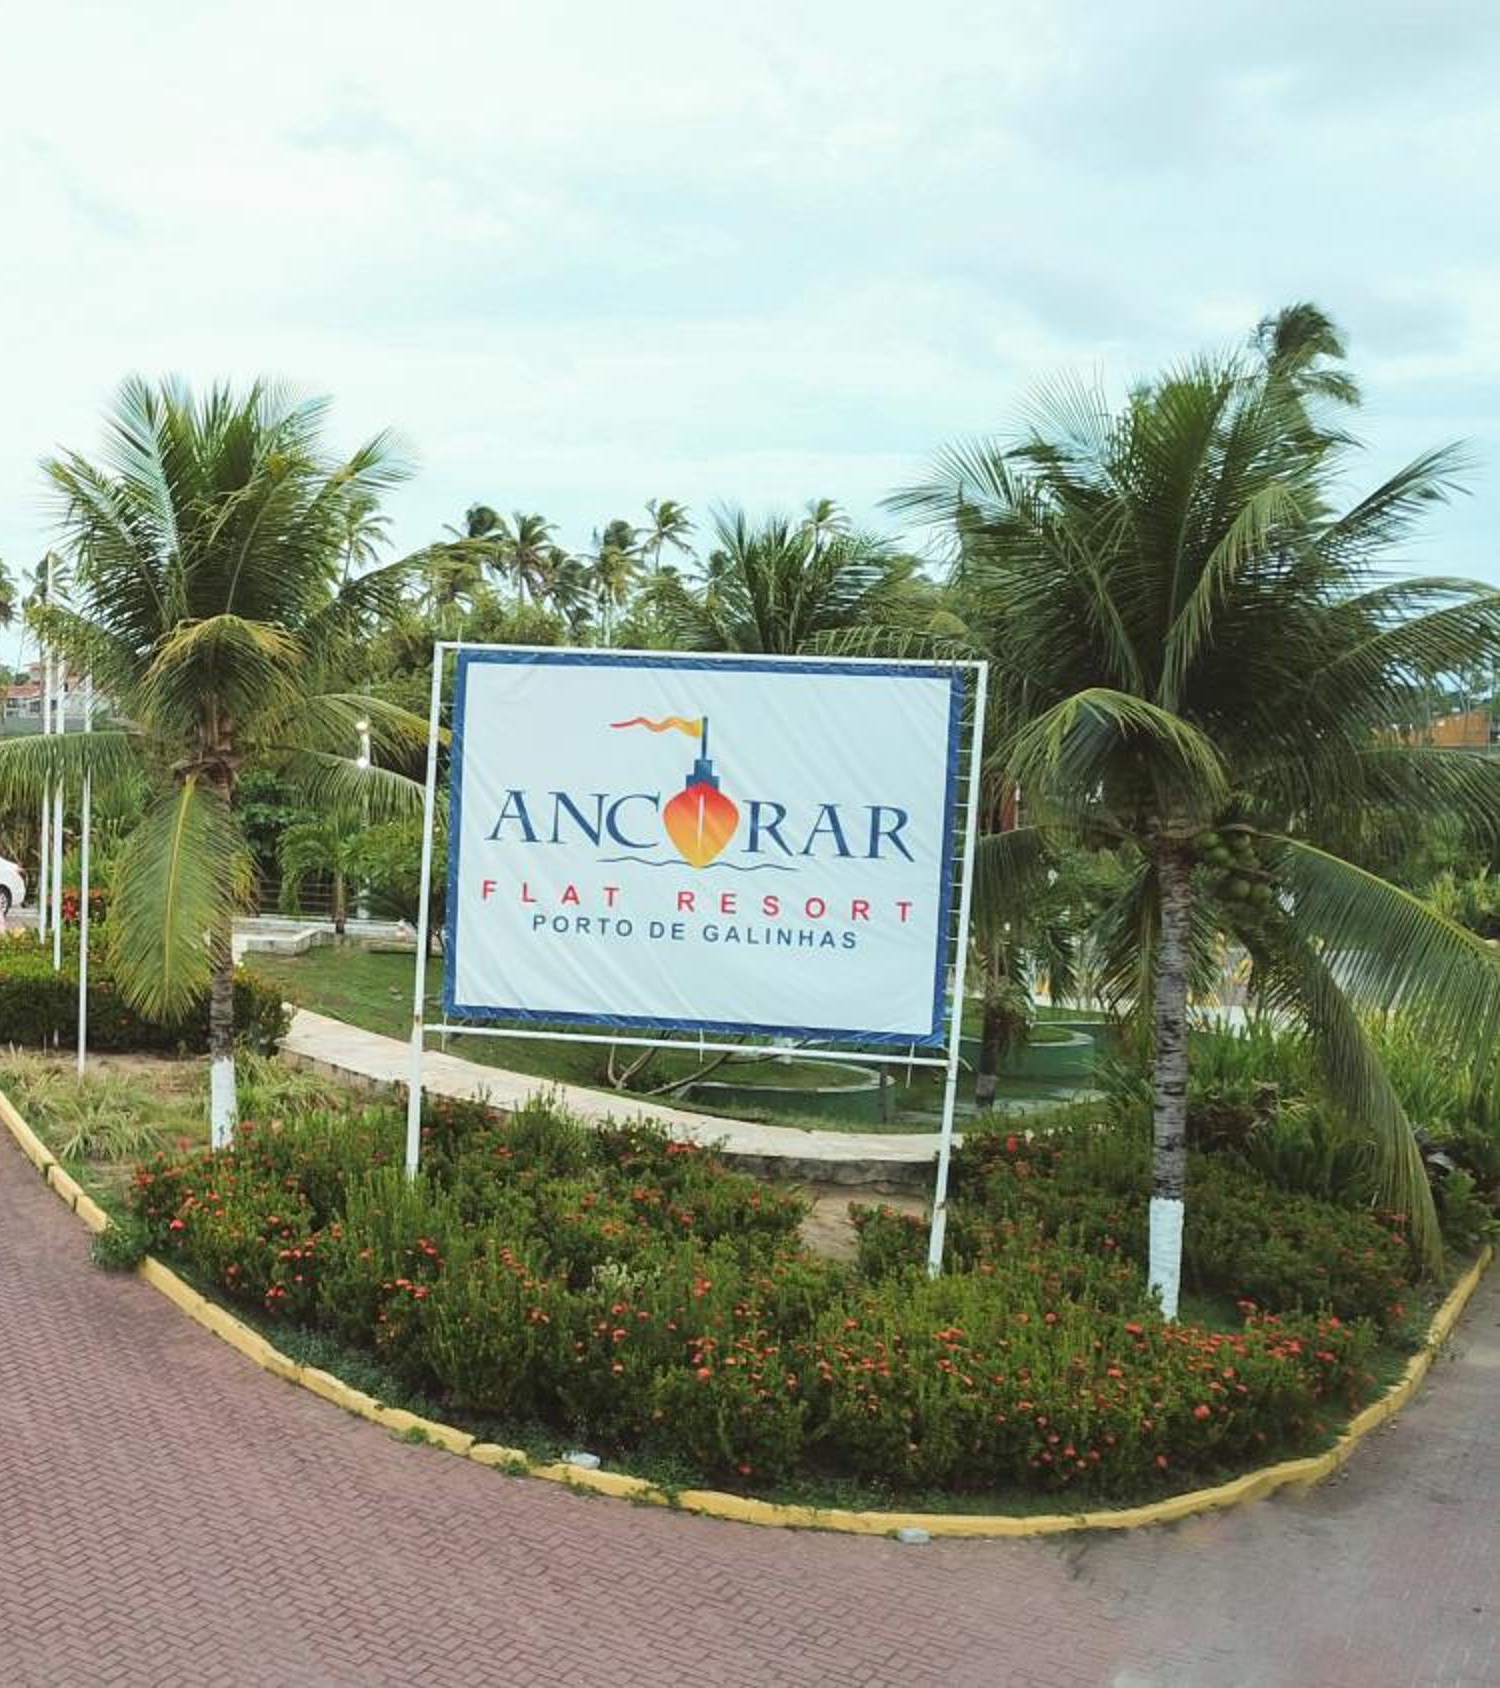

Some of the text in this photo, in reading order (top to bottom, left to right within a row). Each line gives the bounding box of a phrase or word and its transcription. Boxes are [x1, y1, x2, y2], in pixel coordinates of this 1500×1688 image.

[482, 879, 915, 923] FLAT RESORT
[532, 914, 857, 950] PORTO DE GALINHAS
